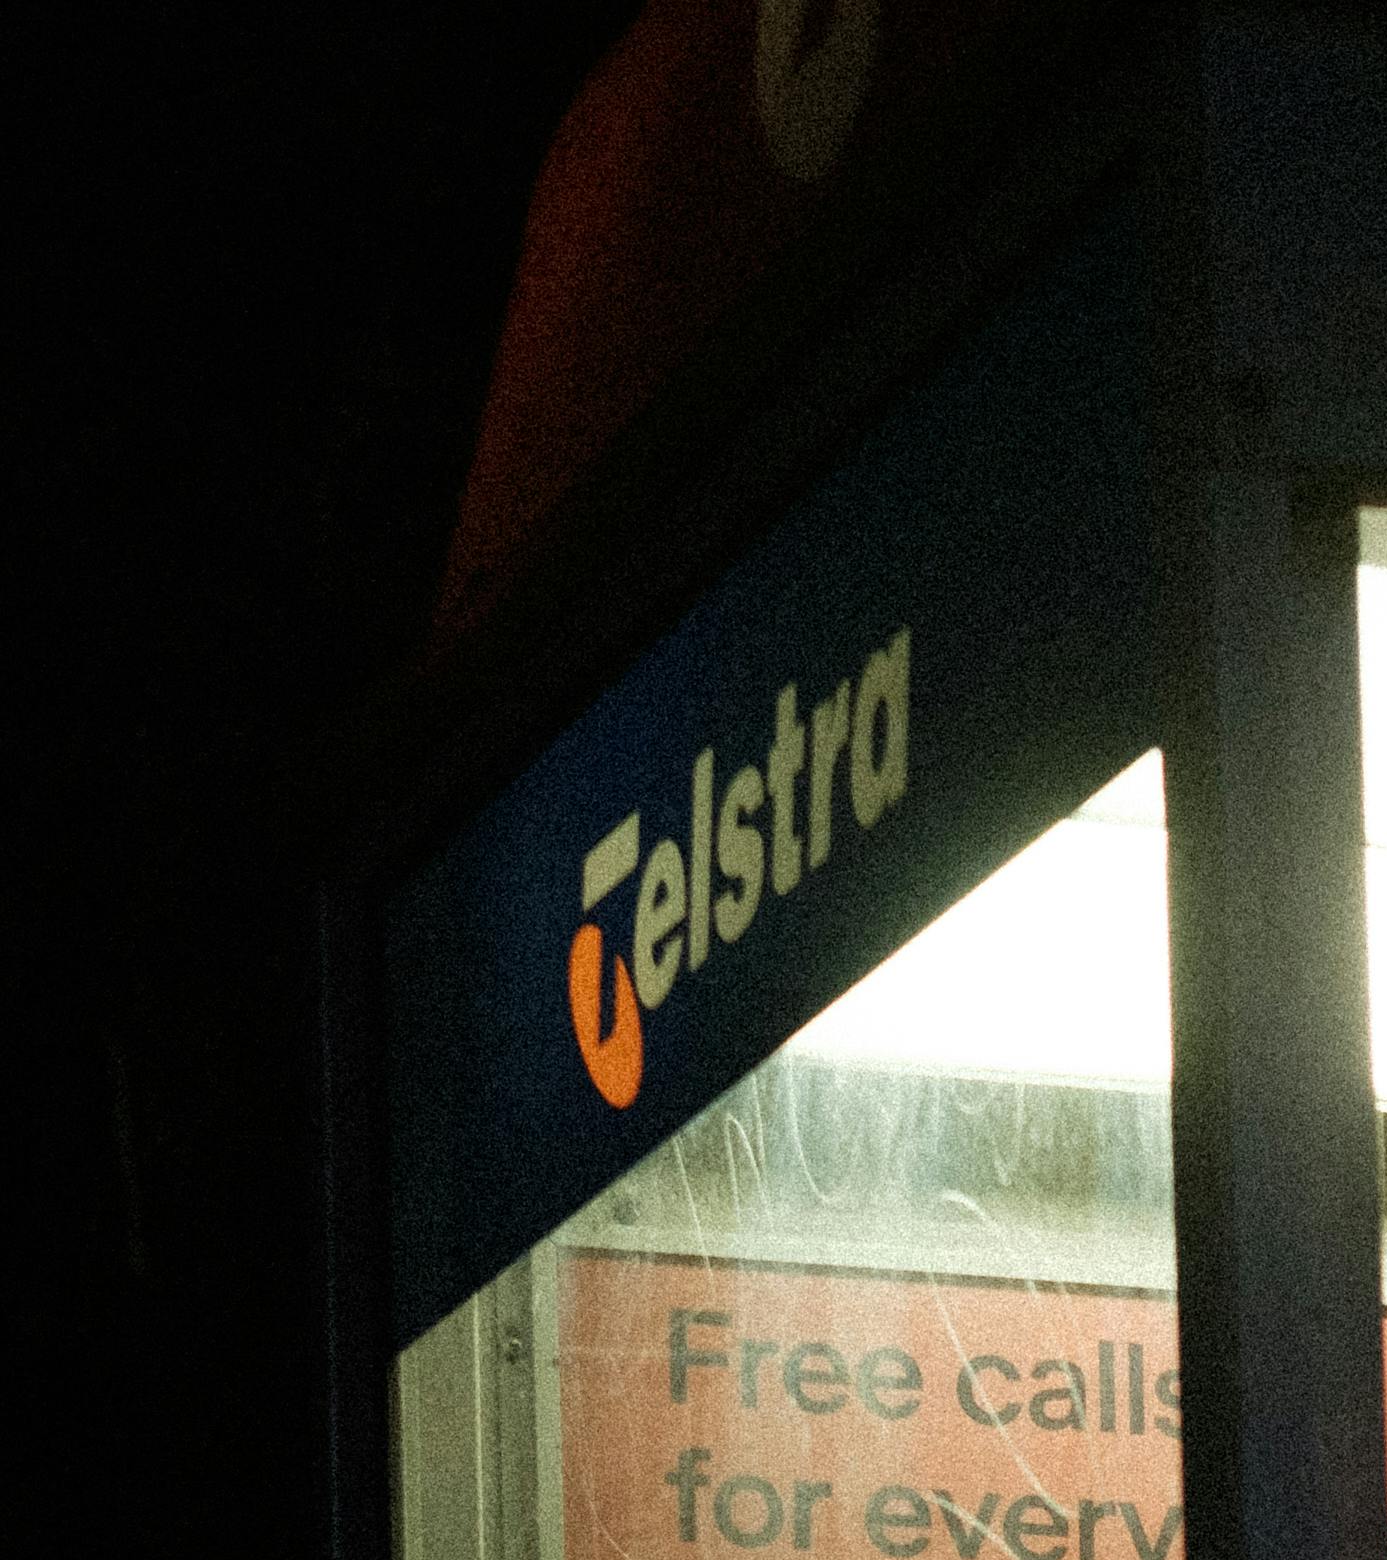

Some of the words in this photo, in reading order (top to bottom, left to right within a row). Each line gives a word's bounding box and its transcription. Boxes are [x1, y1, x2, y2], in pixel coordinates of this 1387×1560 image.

[567, 625, 912, 1110] Telstra
[668, 1309, 922, 1419] Free
[957, 1340, 1182, 1436] calls
[665, 1448, 832, 1550] for
